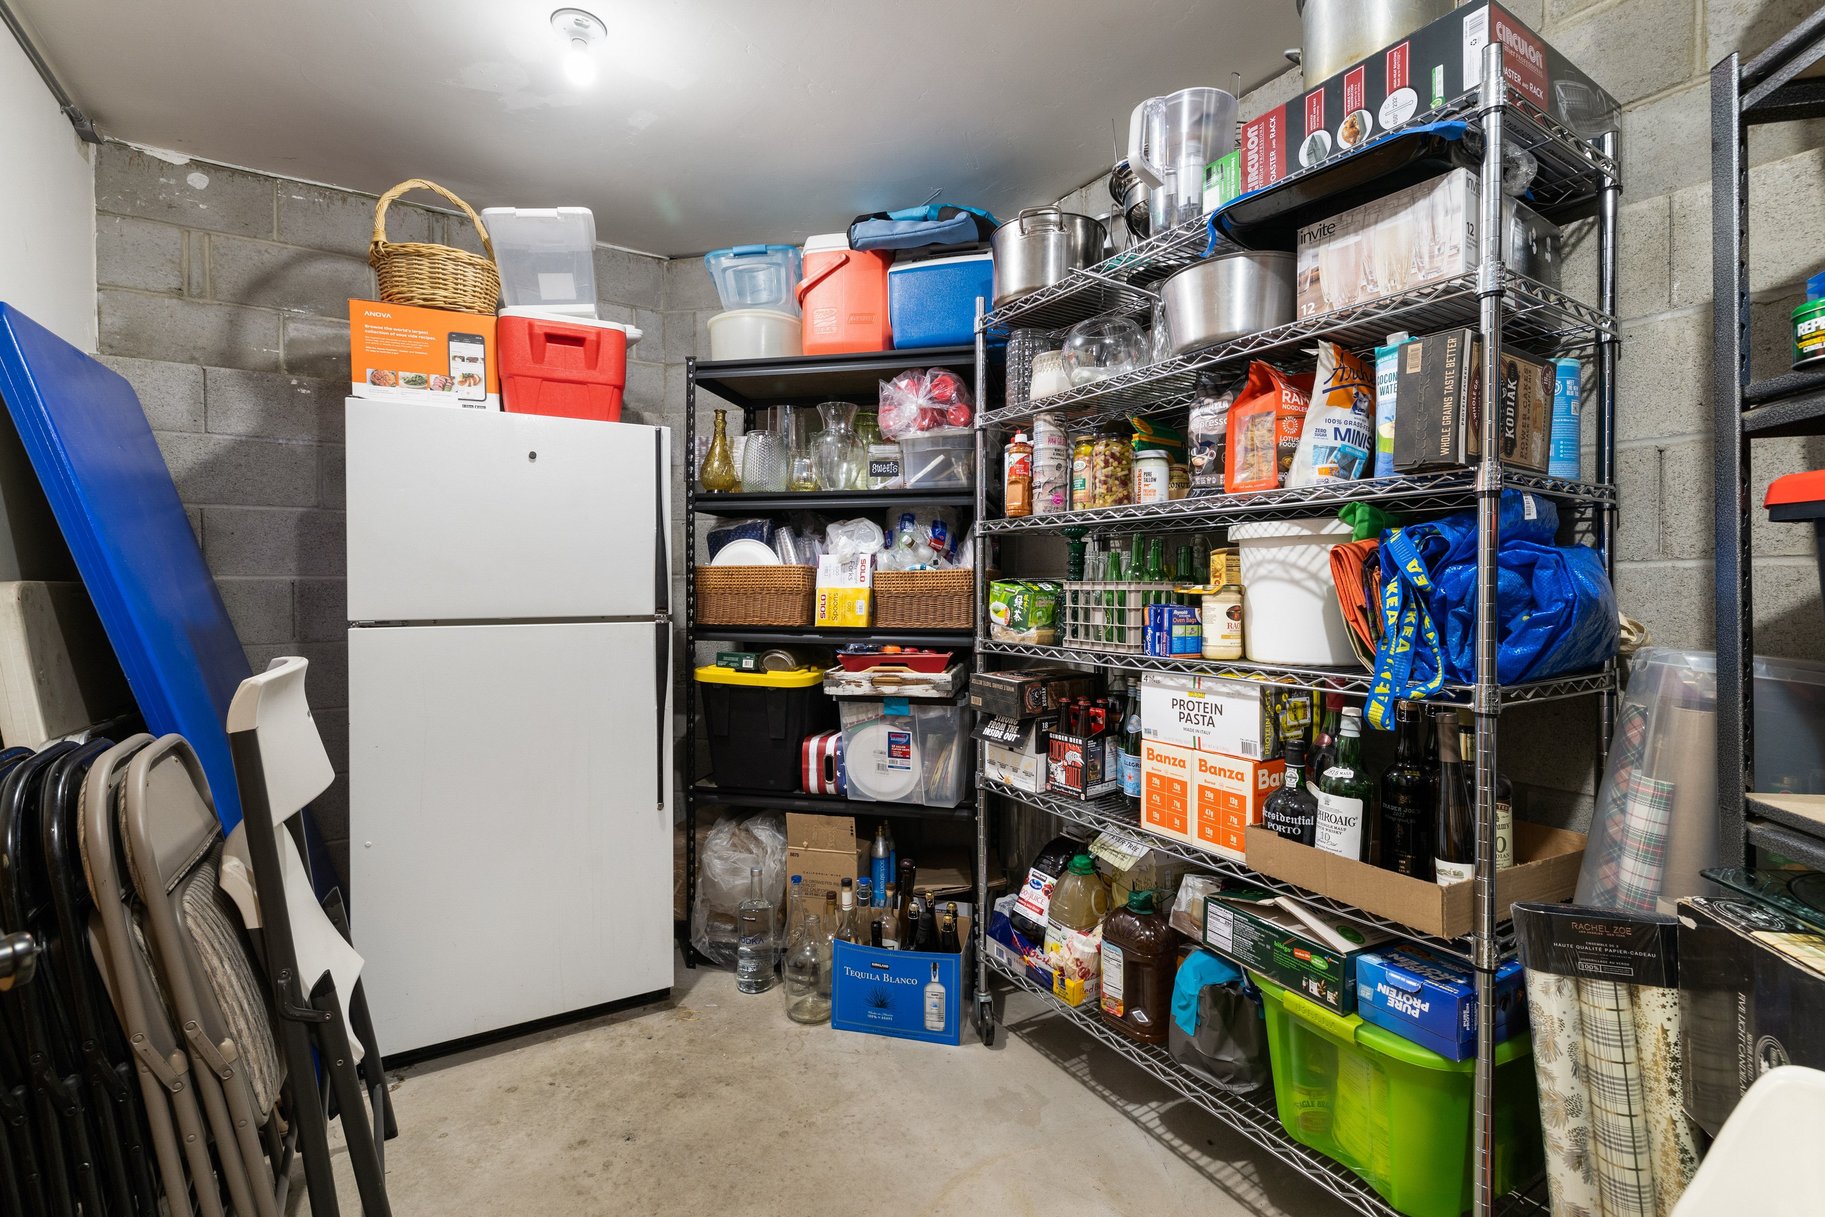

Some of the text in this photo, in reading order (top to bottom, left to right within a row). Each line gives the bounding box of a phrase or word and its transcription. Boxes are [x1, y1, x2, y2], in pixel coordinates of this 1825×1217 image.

[1504, 67, 1521, 86] ASTER
[1530, 83, 1544, 99] RACK
[1300, 222, 1336, 244] invite
[1467, 222, 1474, 236] 12
[364, 310, 392, 318] ANOVA
[1302, 303, 1315, 316] 12
[1798, 316, 1825, 337] REPE
[1380, 386, 1397, 396] WATE
[1440, 337, 1457, 456] WHOLE GRAINS TASTE BETTER
[1505, 378, 1518, 438] KODIAK
[1334, 427, 1372, 450] MINIS
[1171, 698, 1223, 716] PROTEIN
[988, 720, 1019, 733] FROM THE
[1178, 711, 1216, 727] PASTA
[983, 727, 1018, 742] INSIDE OUT
[1049, 733, 1068, 741] GINGER
[1146, 748, 1186, 768] Banza
[1199, 758, 1245, 782] Banza
[1318, 809, 1356, 827] PHROAIG
[1267, 821, 1301, 836] PORTO
[1230, 835, 1237, 843] 3g
[1572, 922, 1632, 935] RACHEL ZOE
[1274, 941, 1292, 952] bibigo
[1605, 948, 1656, 958] PAPIER-CADEAU
[844, 966, 918, 985] TEQUILA BLANCO
[1377, 982, 1430, 1013] PROTEIN
[1387, 996, 1420, 1018] PURE
